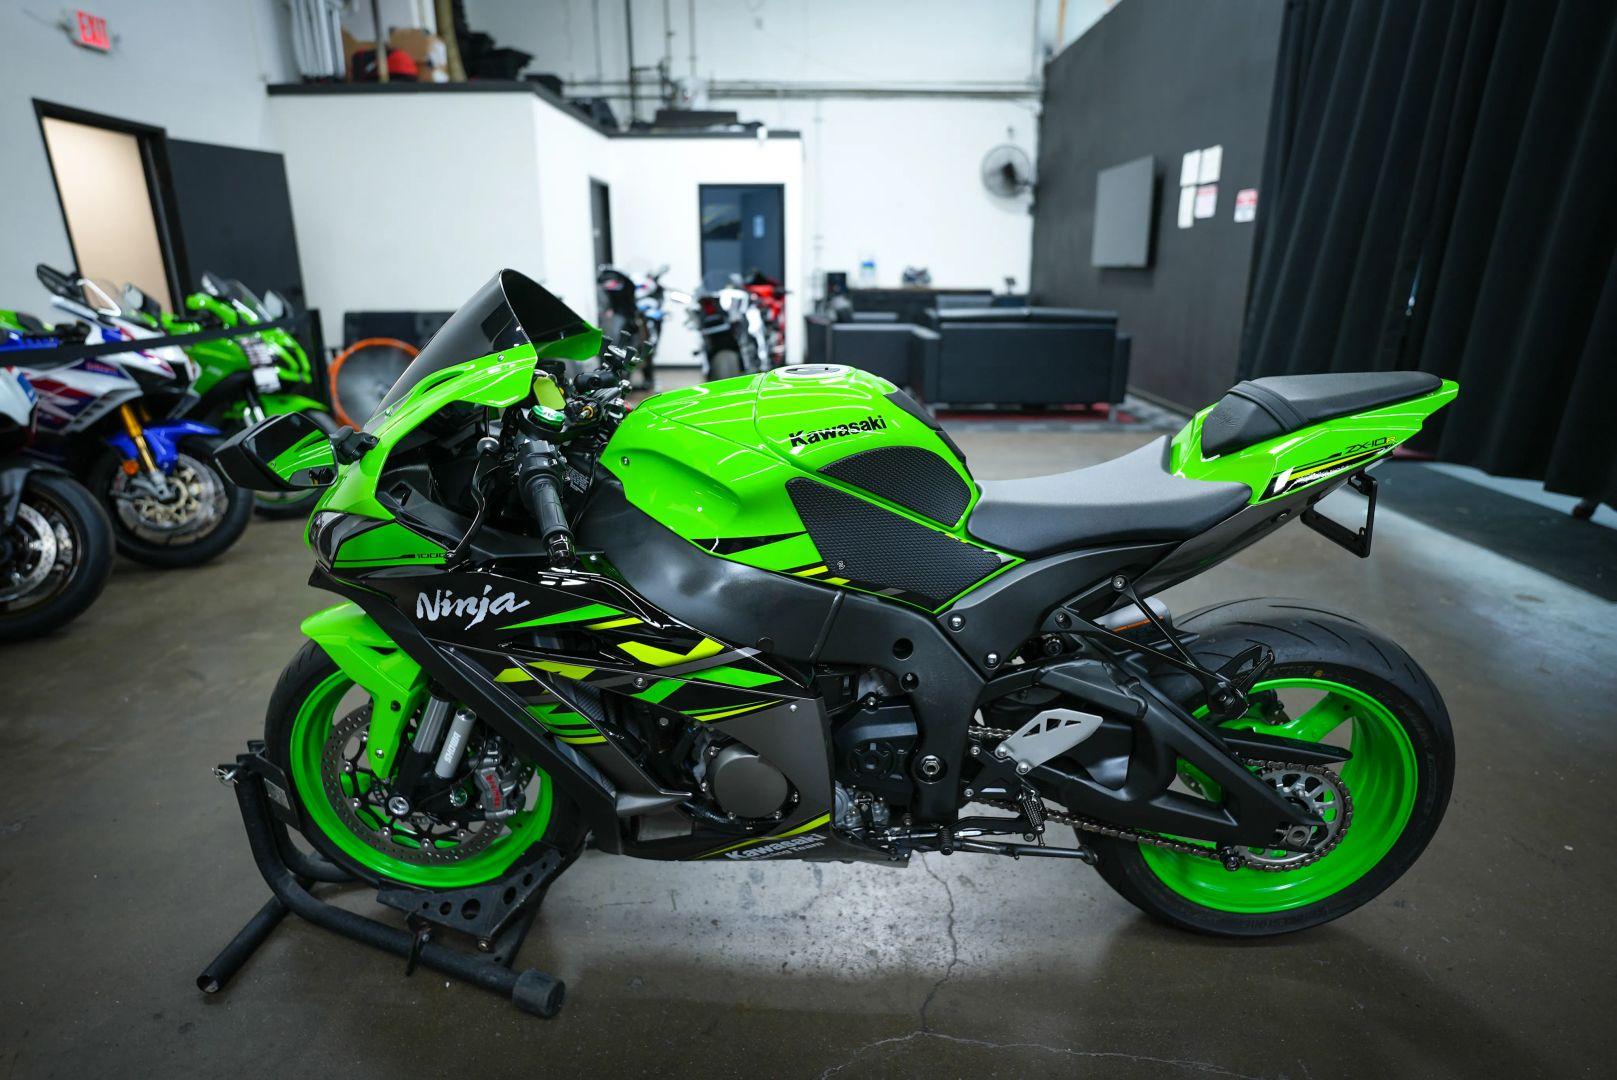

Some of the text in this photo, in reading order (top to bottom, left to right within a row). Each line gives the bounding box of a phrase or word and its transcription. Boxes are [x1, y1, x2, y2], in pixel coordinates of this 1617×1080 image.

[77, 10, 110, 49] EXIT
[789, 415, 887, 447] Kawasaki
[1345, 436, 1396, 454] ZX-10R
[416, 584, 531, 631] Ninja
[444, 731, 461, 764] SHOWA
[724, 833, 827, 860] Kawasaki
